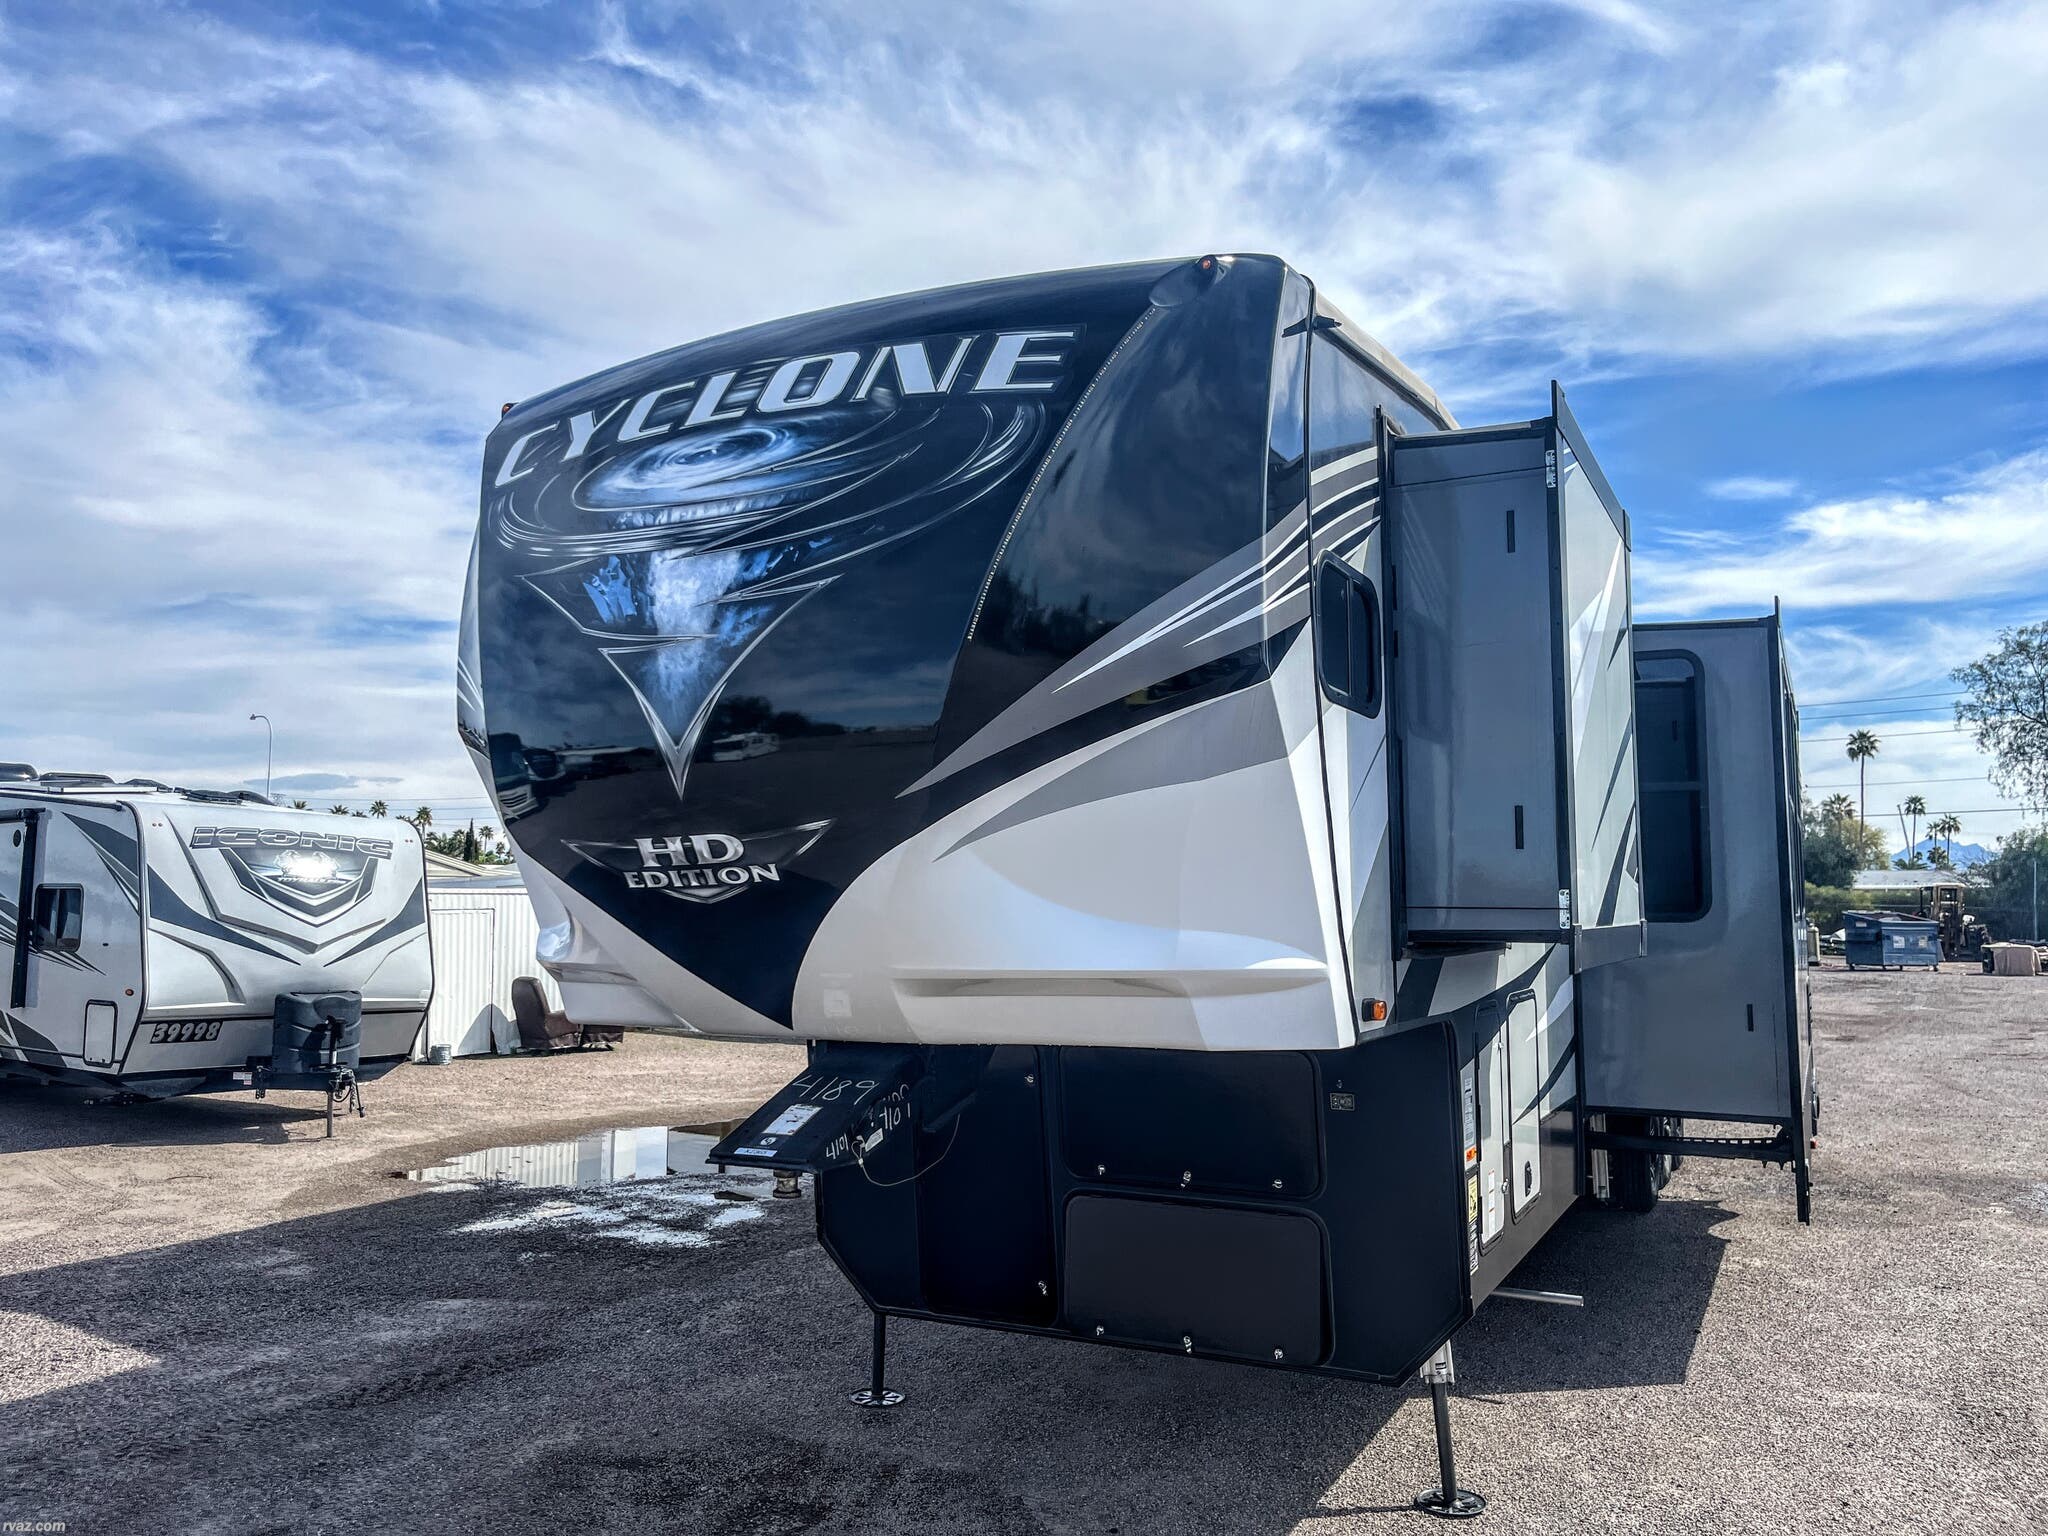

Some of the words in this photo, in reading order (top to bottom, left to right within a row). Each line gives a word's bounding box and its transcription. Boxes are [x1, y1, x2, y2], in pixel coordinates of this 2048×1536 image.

[493, 330, 1076, 488] CYCLONE
[189, 826, 394, 860] ICONIC
[634, 833, 744, 868] HD
[623, 863, 780, 889] EDITION
[151, 1021, 221, 1043] 39998
[792, 1074, 880, 1106] 4189
[826, 1132, 849, 1160] 4101
